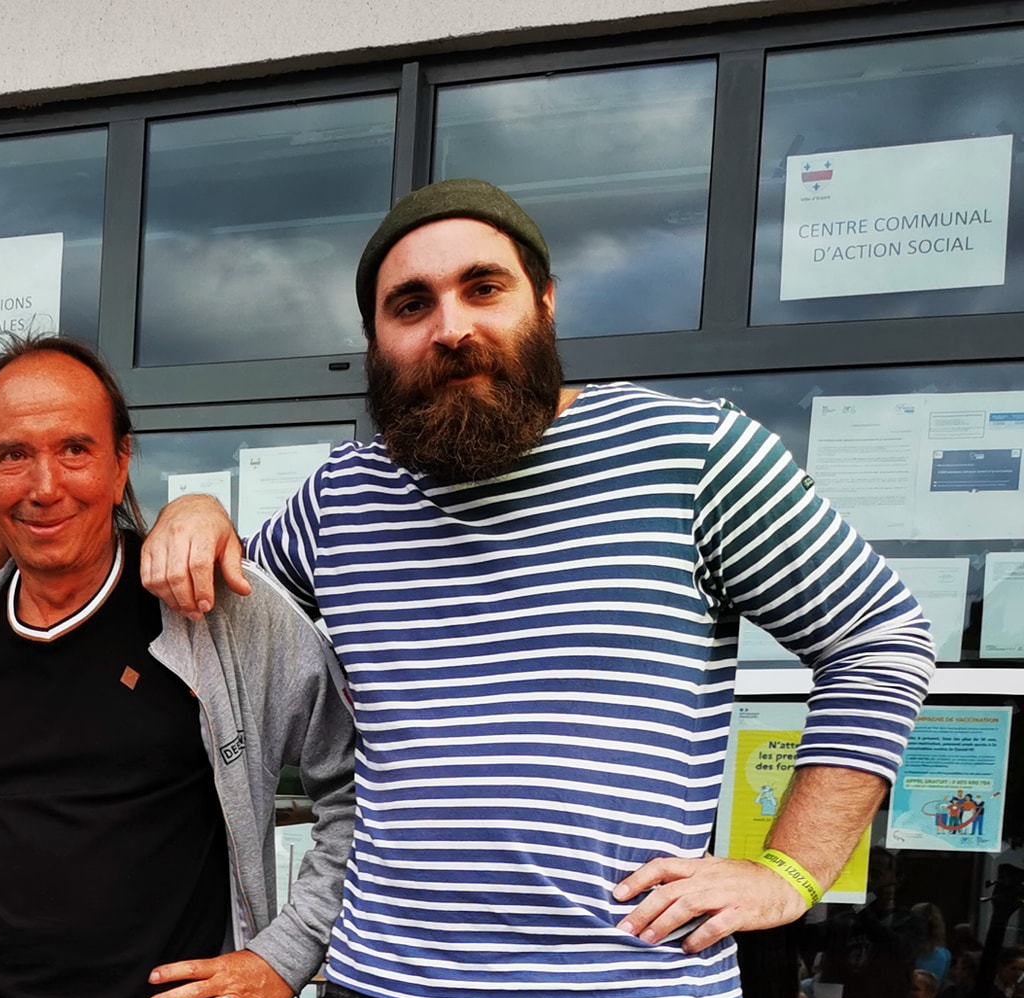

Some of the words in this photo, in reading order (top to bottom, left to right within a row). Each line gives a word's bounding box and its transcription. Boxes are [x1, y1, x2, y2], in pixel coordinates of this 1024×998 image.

[798, 218, 869, 239] CENTRE
[872, 208, 992, 233] COMMUNAL
[813, 241, 901, 263] D'ACTION
[907, 236, 974, 255] SOCIAL
[759, 751, 773, 760] les
[755, 763, 773, 771] des
[785, 865, 805, 884] 2021
